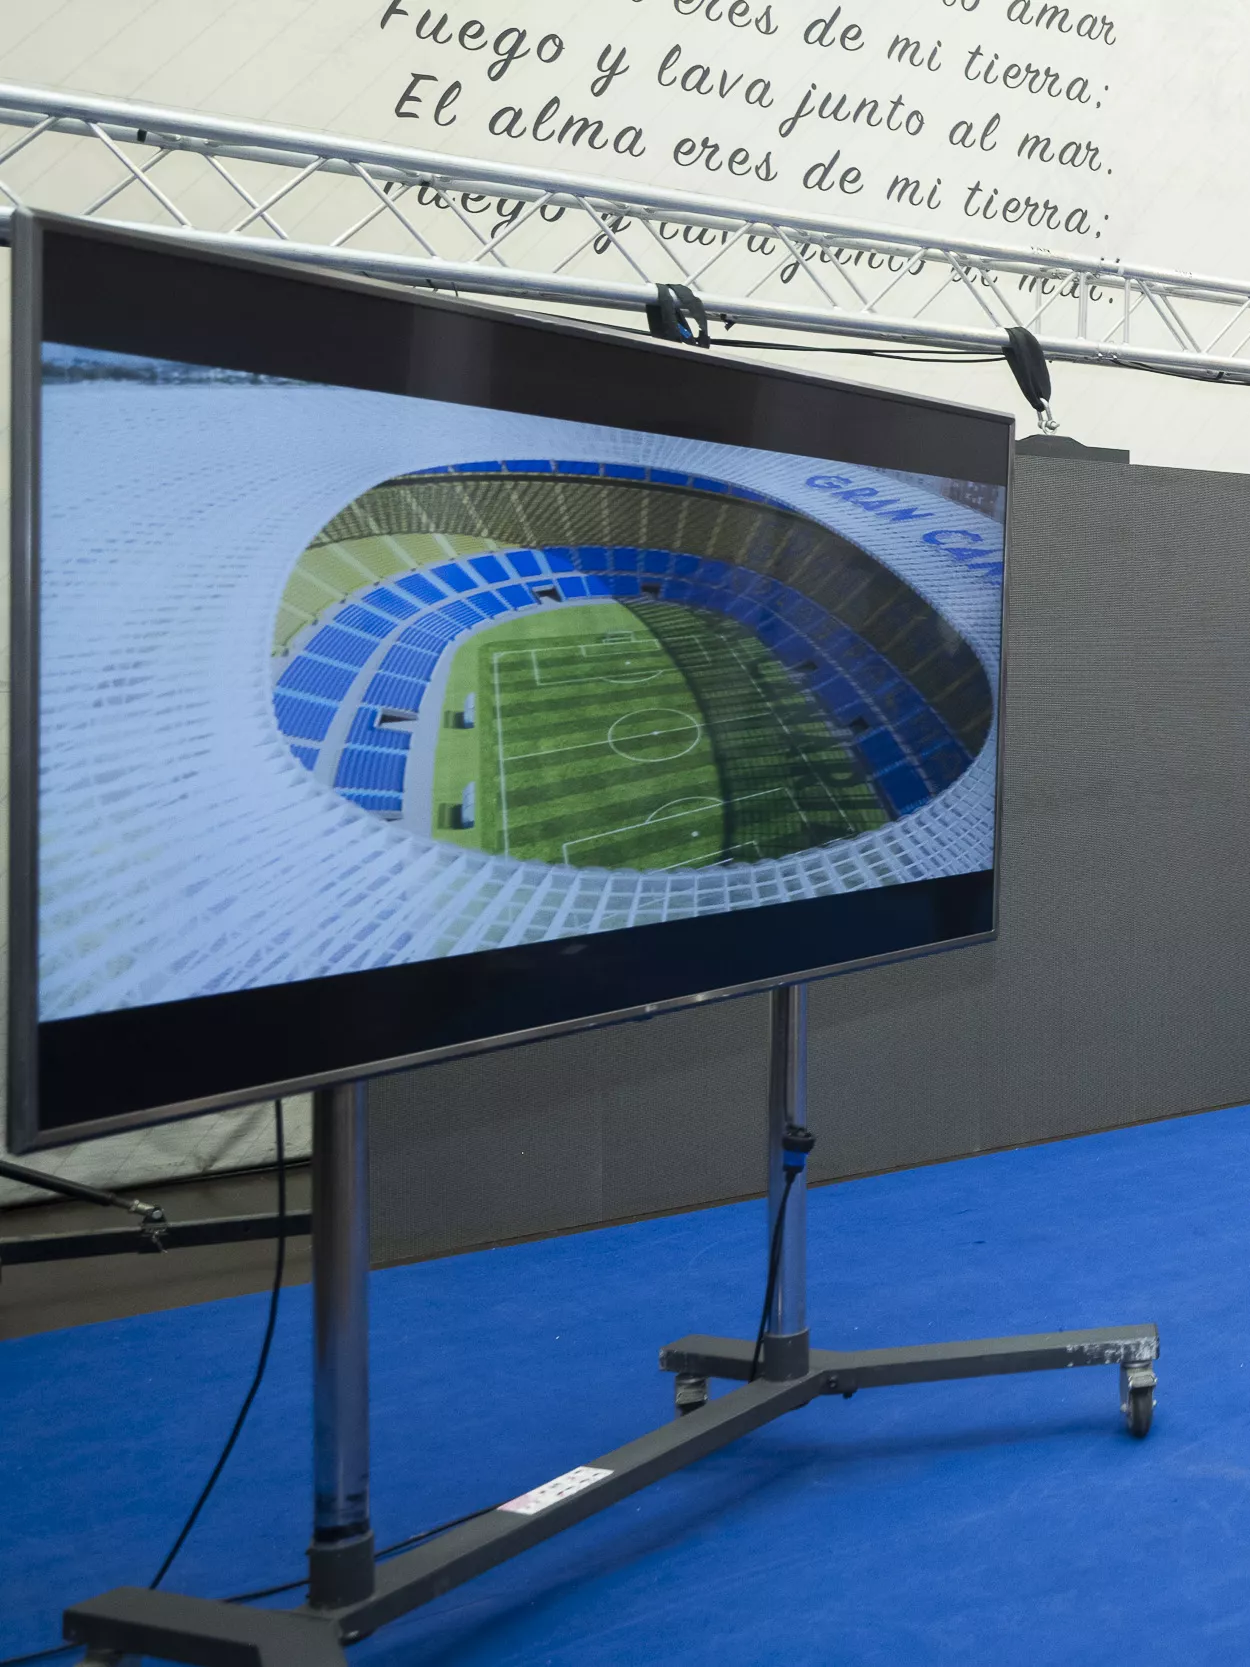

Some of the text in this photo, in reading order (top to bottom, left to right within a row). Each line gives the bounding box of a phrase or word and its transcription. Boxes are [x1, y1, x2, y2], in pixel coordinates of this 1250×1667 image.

[673, 0, 779, 36] eres
[803, 5, 865, 52] de
[887, 34, 942, 72] mi
[1006, 0, 1117, 46] amar
[380, 0, 1113, 176] Fuego y lava junto al mar.
[394, 72, 462, 127] El
[488, 95, 646, 158] alma
[673, 136, 778, 182] eres
[802, 149, 864, 195] de
[886, 175, 942, 210] mi
